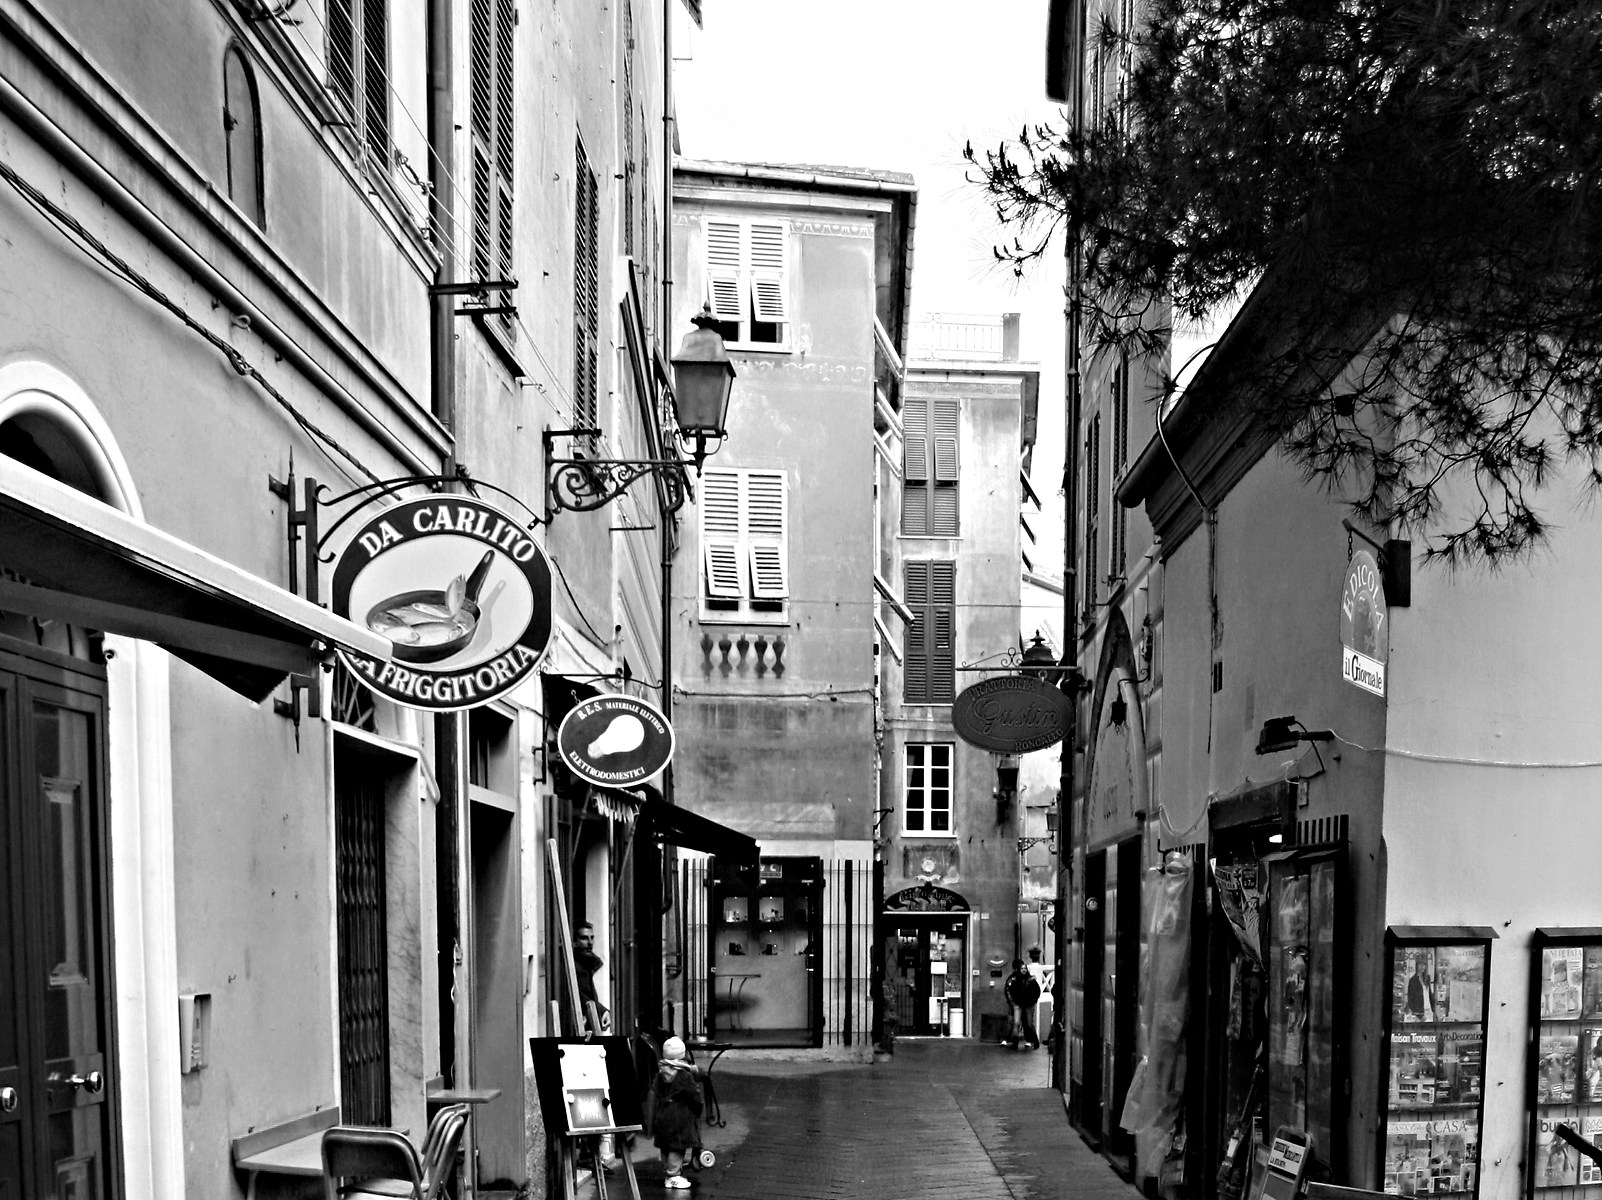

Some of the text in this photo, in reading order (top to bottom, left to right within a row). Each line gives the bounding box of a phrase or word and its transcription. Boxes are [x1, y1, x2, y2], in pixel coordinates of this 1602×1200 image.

[359, 504, 536, 563] DA CARLITO
[1342, 564, 1385, 630] EDICOLA
[377, 644, 540, 702] FRIGGITORIA
[1344, 654, 1383, 690] il Giornale
[964, 678, 1036, 701] TRATTORIA
[605, 701, 639, 713] MATERIALE
[639, 708, 665, 734] ELETTRICO
[569, 750, 646, 780] ELETTRODOMESTICI
[1411, 1032, 1437, 1043] Travaux
[1433, 1120, 1467, 1133] CASA
